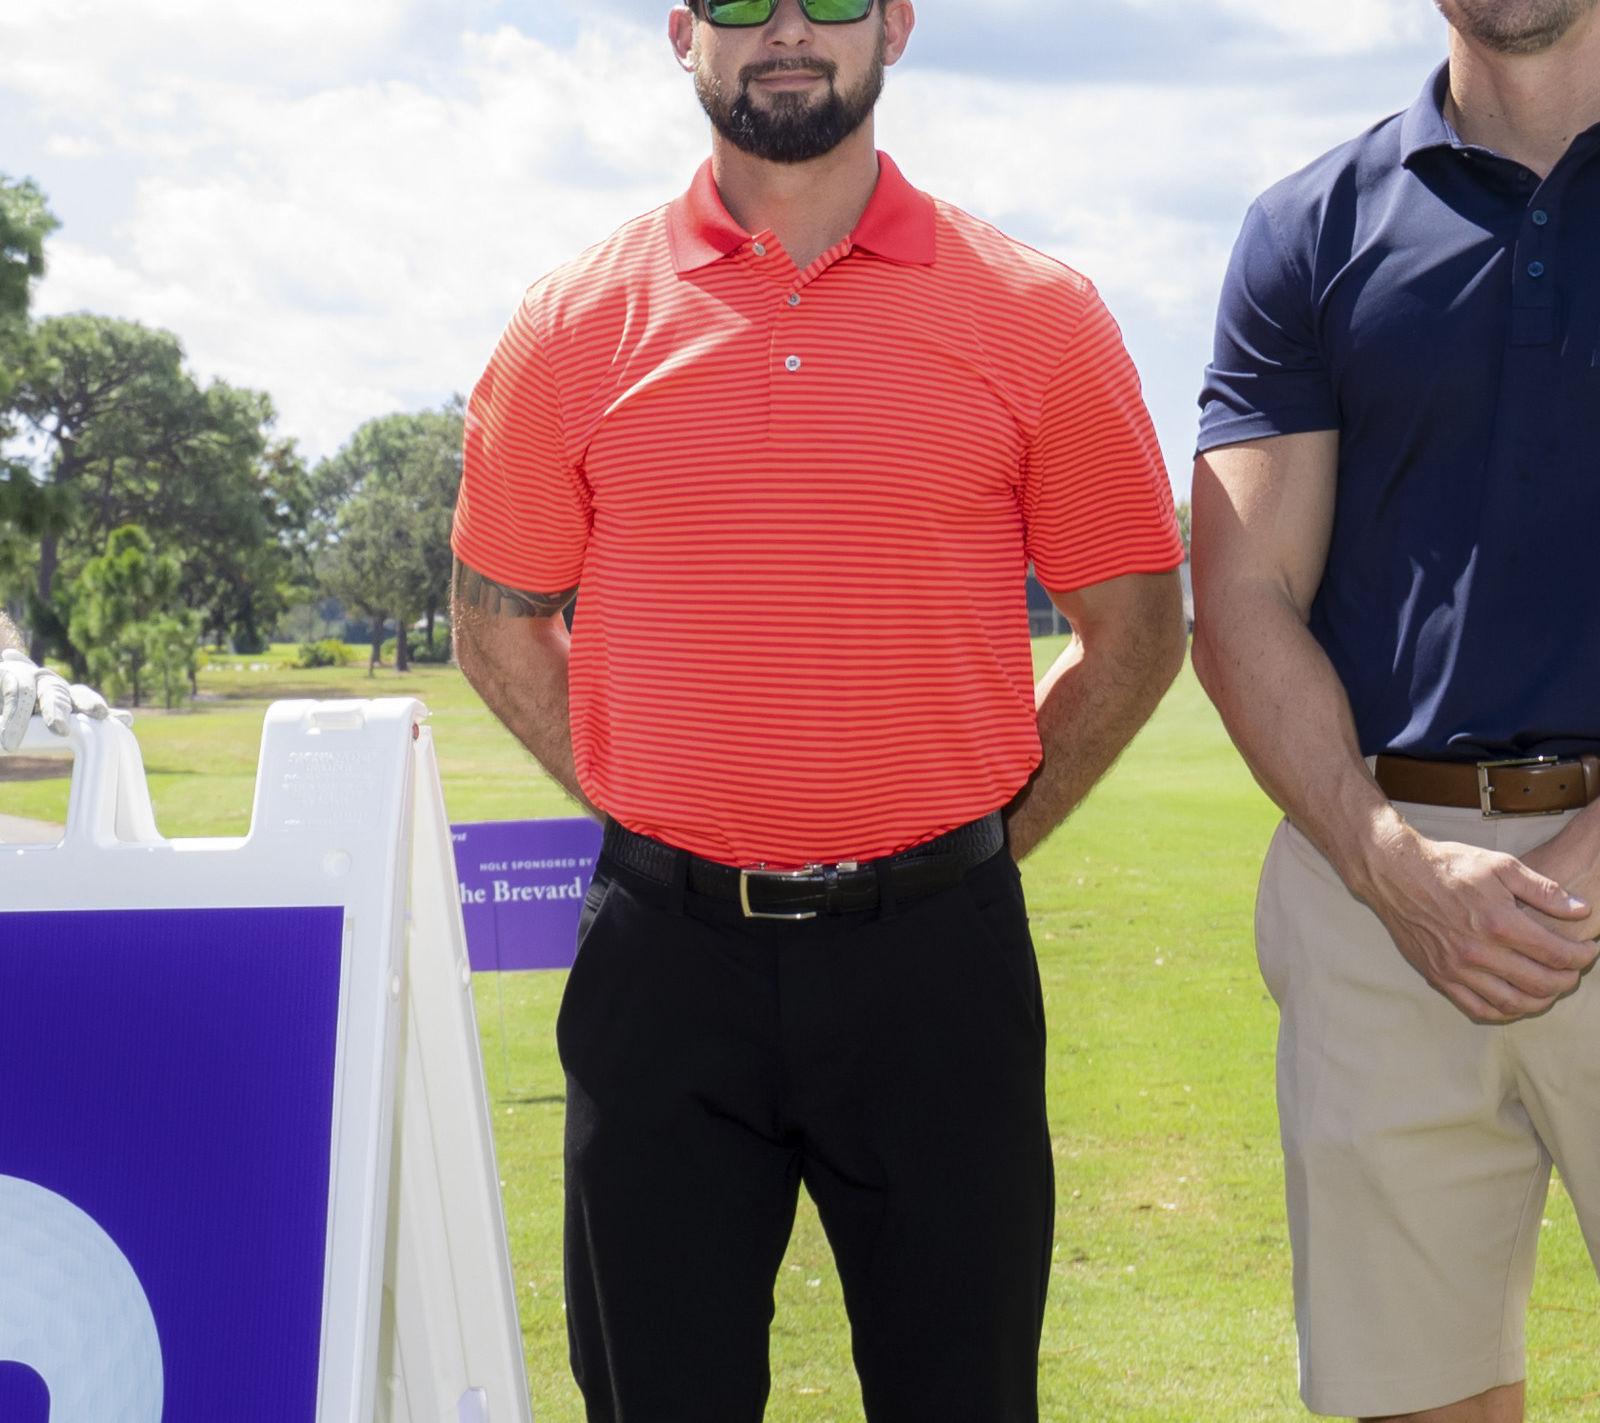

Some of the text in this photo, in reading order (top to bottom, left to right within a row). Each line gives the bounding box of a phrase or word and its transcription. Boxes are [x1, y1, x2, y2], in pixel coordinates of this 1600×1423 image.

[480, 857, 593, 872] HOLE SPONSORED BY
[459, 876, 582, 904] he Brevard
